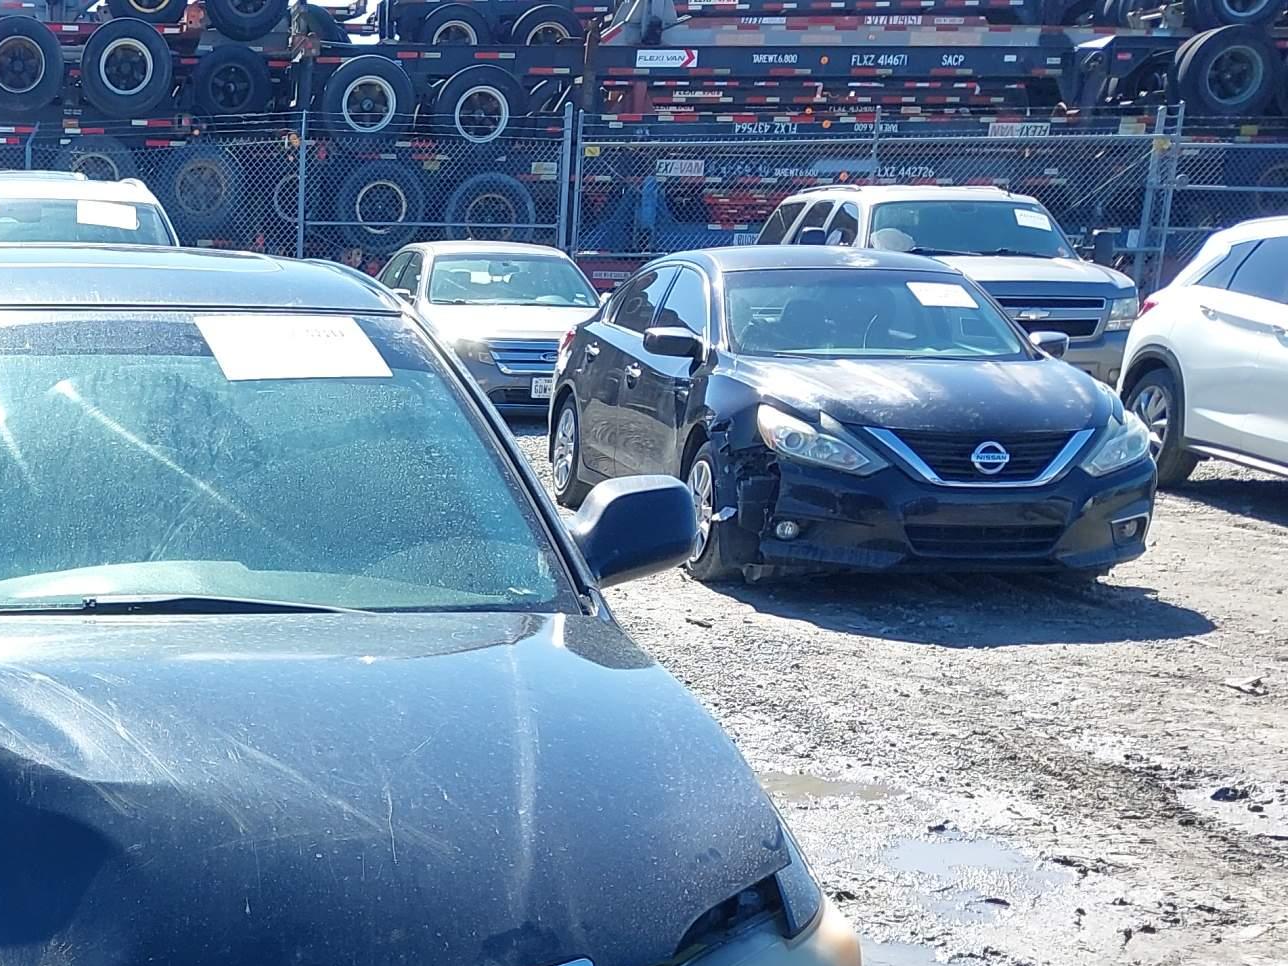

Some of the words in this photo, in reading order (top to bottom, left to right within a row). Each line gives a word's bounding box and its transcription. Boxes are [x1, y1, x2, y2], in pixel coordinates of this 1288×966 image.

[851, 55, 874, 66] FLXZ
[878, 55, 908, 66] 414671
[942, 55, 965, 66] SACP
[774, 123, 797, 134] FLXZ
